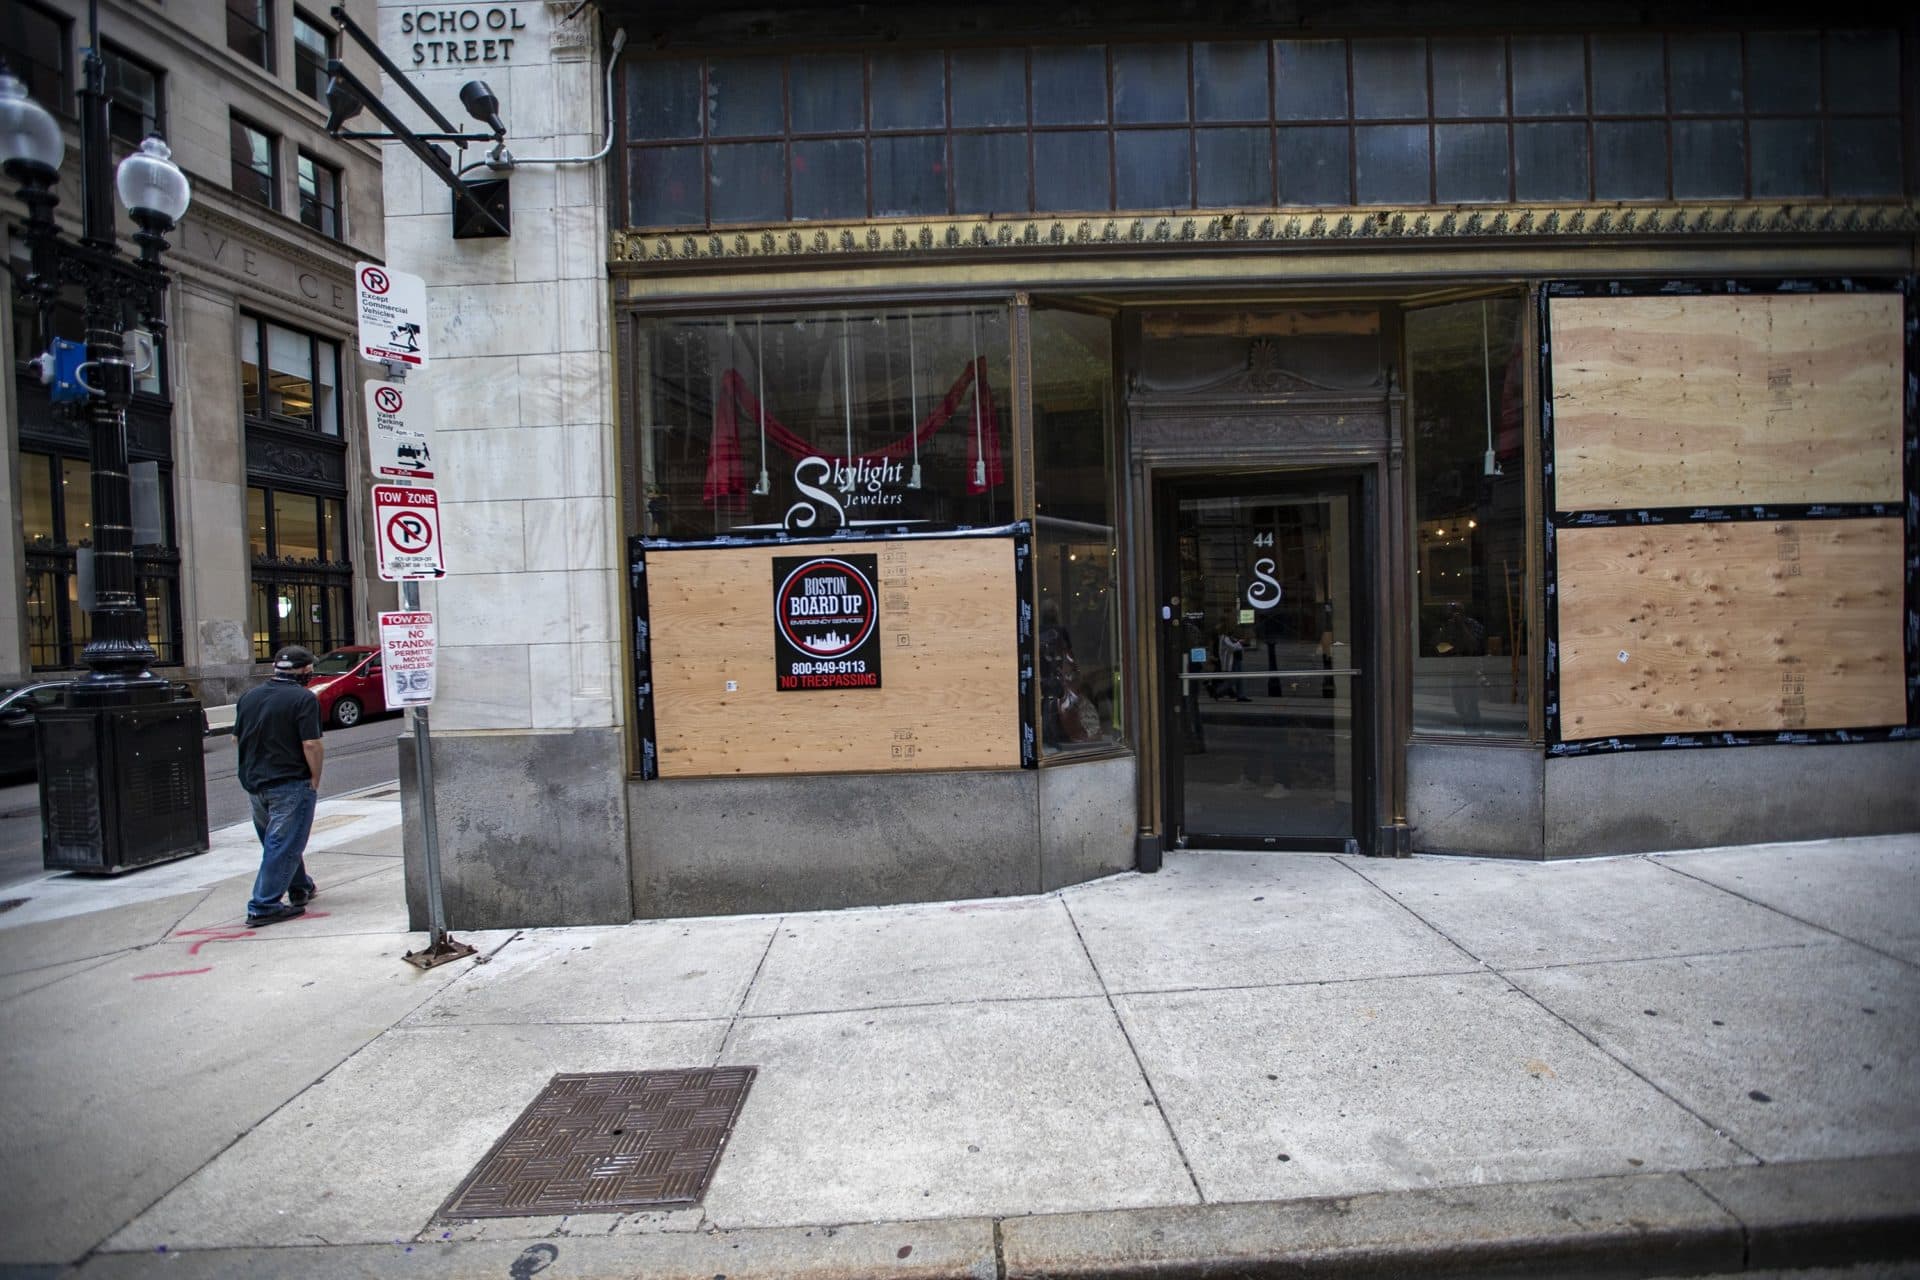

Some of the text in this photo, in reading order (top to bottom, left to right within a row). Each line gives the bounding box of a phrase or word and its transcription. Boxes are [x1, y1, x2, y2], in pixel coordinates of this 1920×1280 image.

[401, 8, 526, 34] SCHOOL
[412, 39, 514, 64] STREET
[361, 291, 389, 303] Except
[362, 299, 408, 315] Commercial
[362, 306, 395, 319] Vehicles
[377, 418, 403, 427] Parking
[377, 423, 394, 432] Only
[377, 492, 435, 504] TOW ZONE
[785, 456, 904, 529] Skylight
[844, 490, 903, 508] Jewelers
[1253, 532, 1274, 547] 44
[804, 576, 847, 596] BOSTON
[1247, 557, 1281, 609] S
[790, 596, 838, 616] BOARD
[842, 595, 862, 614] UP
[388, 615, 412, 625] TOW
[408, 630, 425, 638] NO
[792, 660, 865, 675] 800-949-9113
[782, 673, 877, 688] NO TRESPASSING
